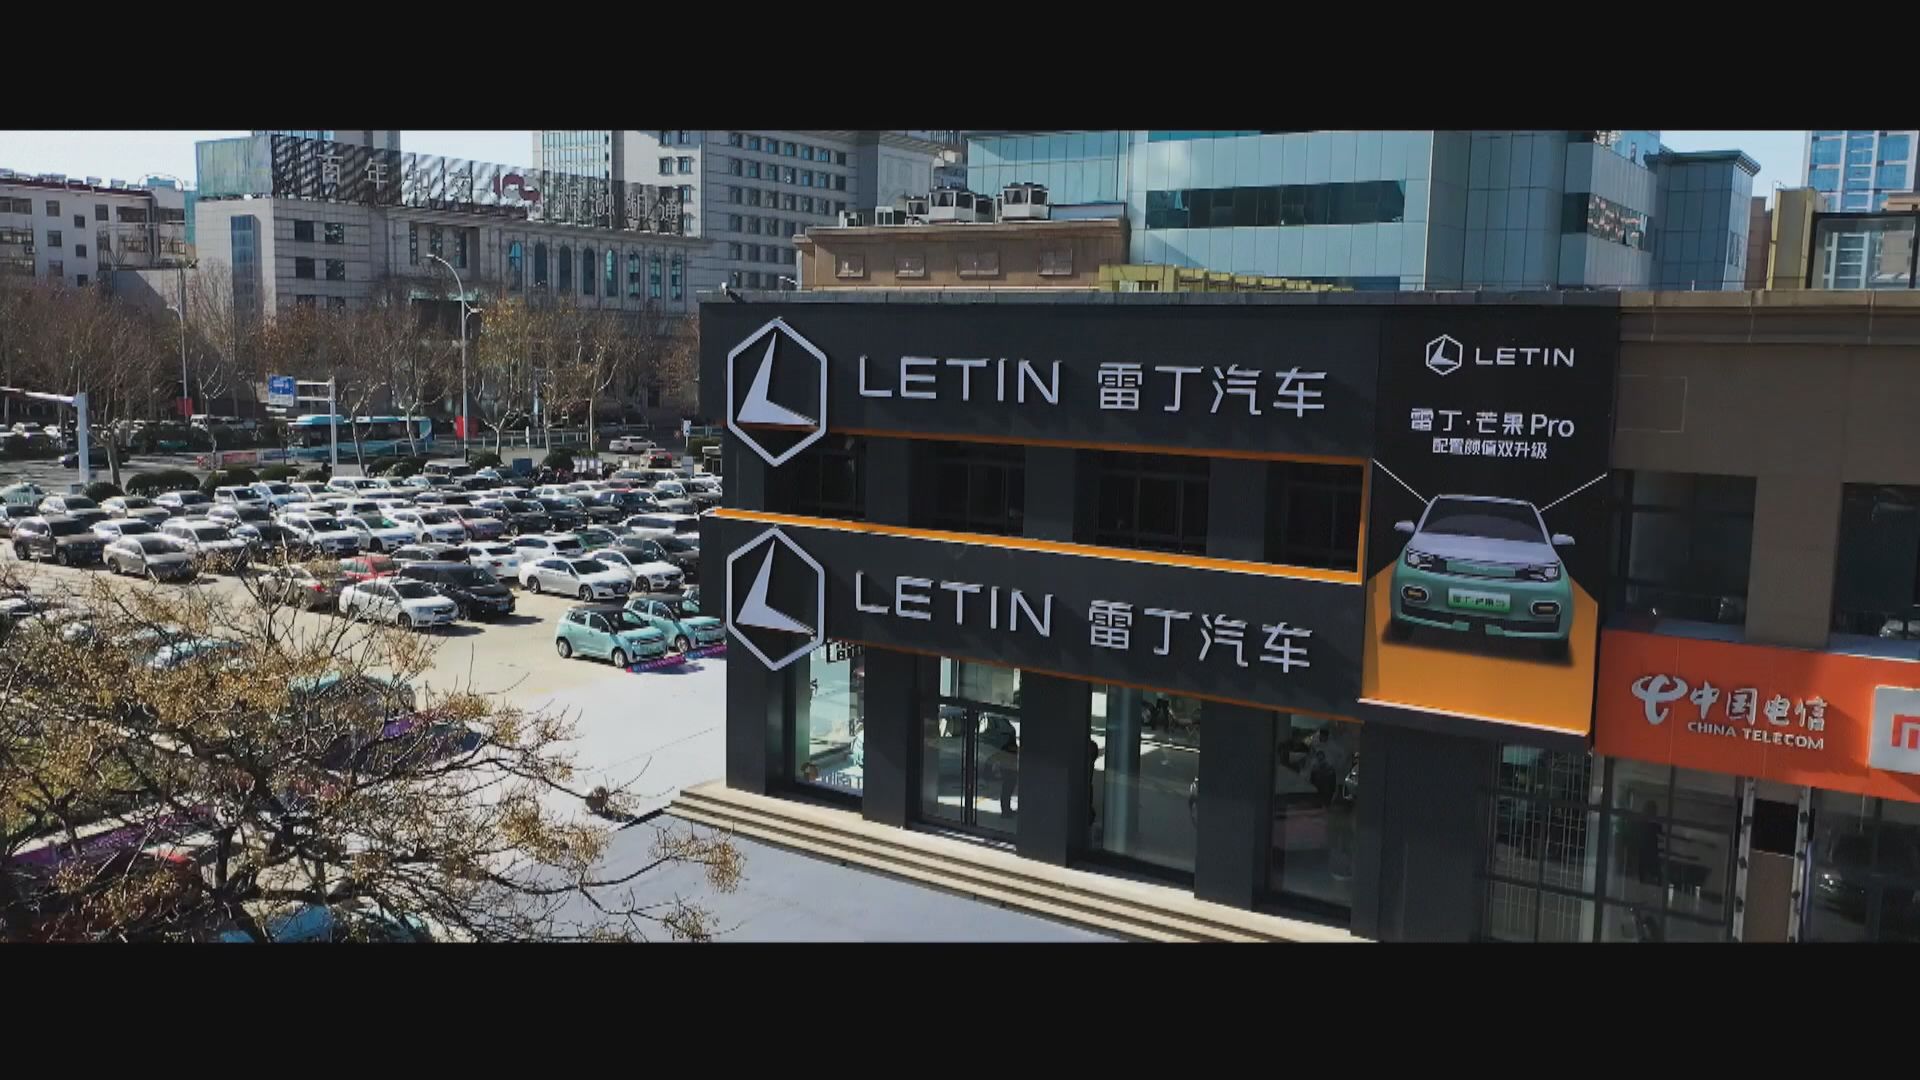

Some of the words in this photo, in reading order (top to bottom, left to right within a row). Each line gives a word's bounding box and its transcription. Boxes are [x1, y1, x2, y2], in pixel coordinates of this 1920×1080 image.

[1475, 347, 1575, 368] LETIN
[859, 355, 1062, 404] LETIN
[1097, 361, 1327, 418] 雷丁汽车
[1530, 413, 1575, 438] Pro
[1432, 437, 1548, 460] 配置颜值双升级
[854, 570, 1053, 639] LETIN
[1087, 599, 1313, 674] 雷丁汽车
[1689, 680, 1828, 732] 中国电信
[1687, 721, 1737, 738] CHINA
[1743, 727, 1824, 751] TELECOM
